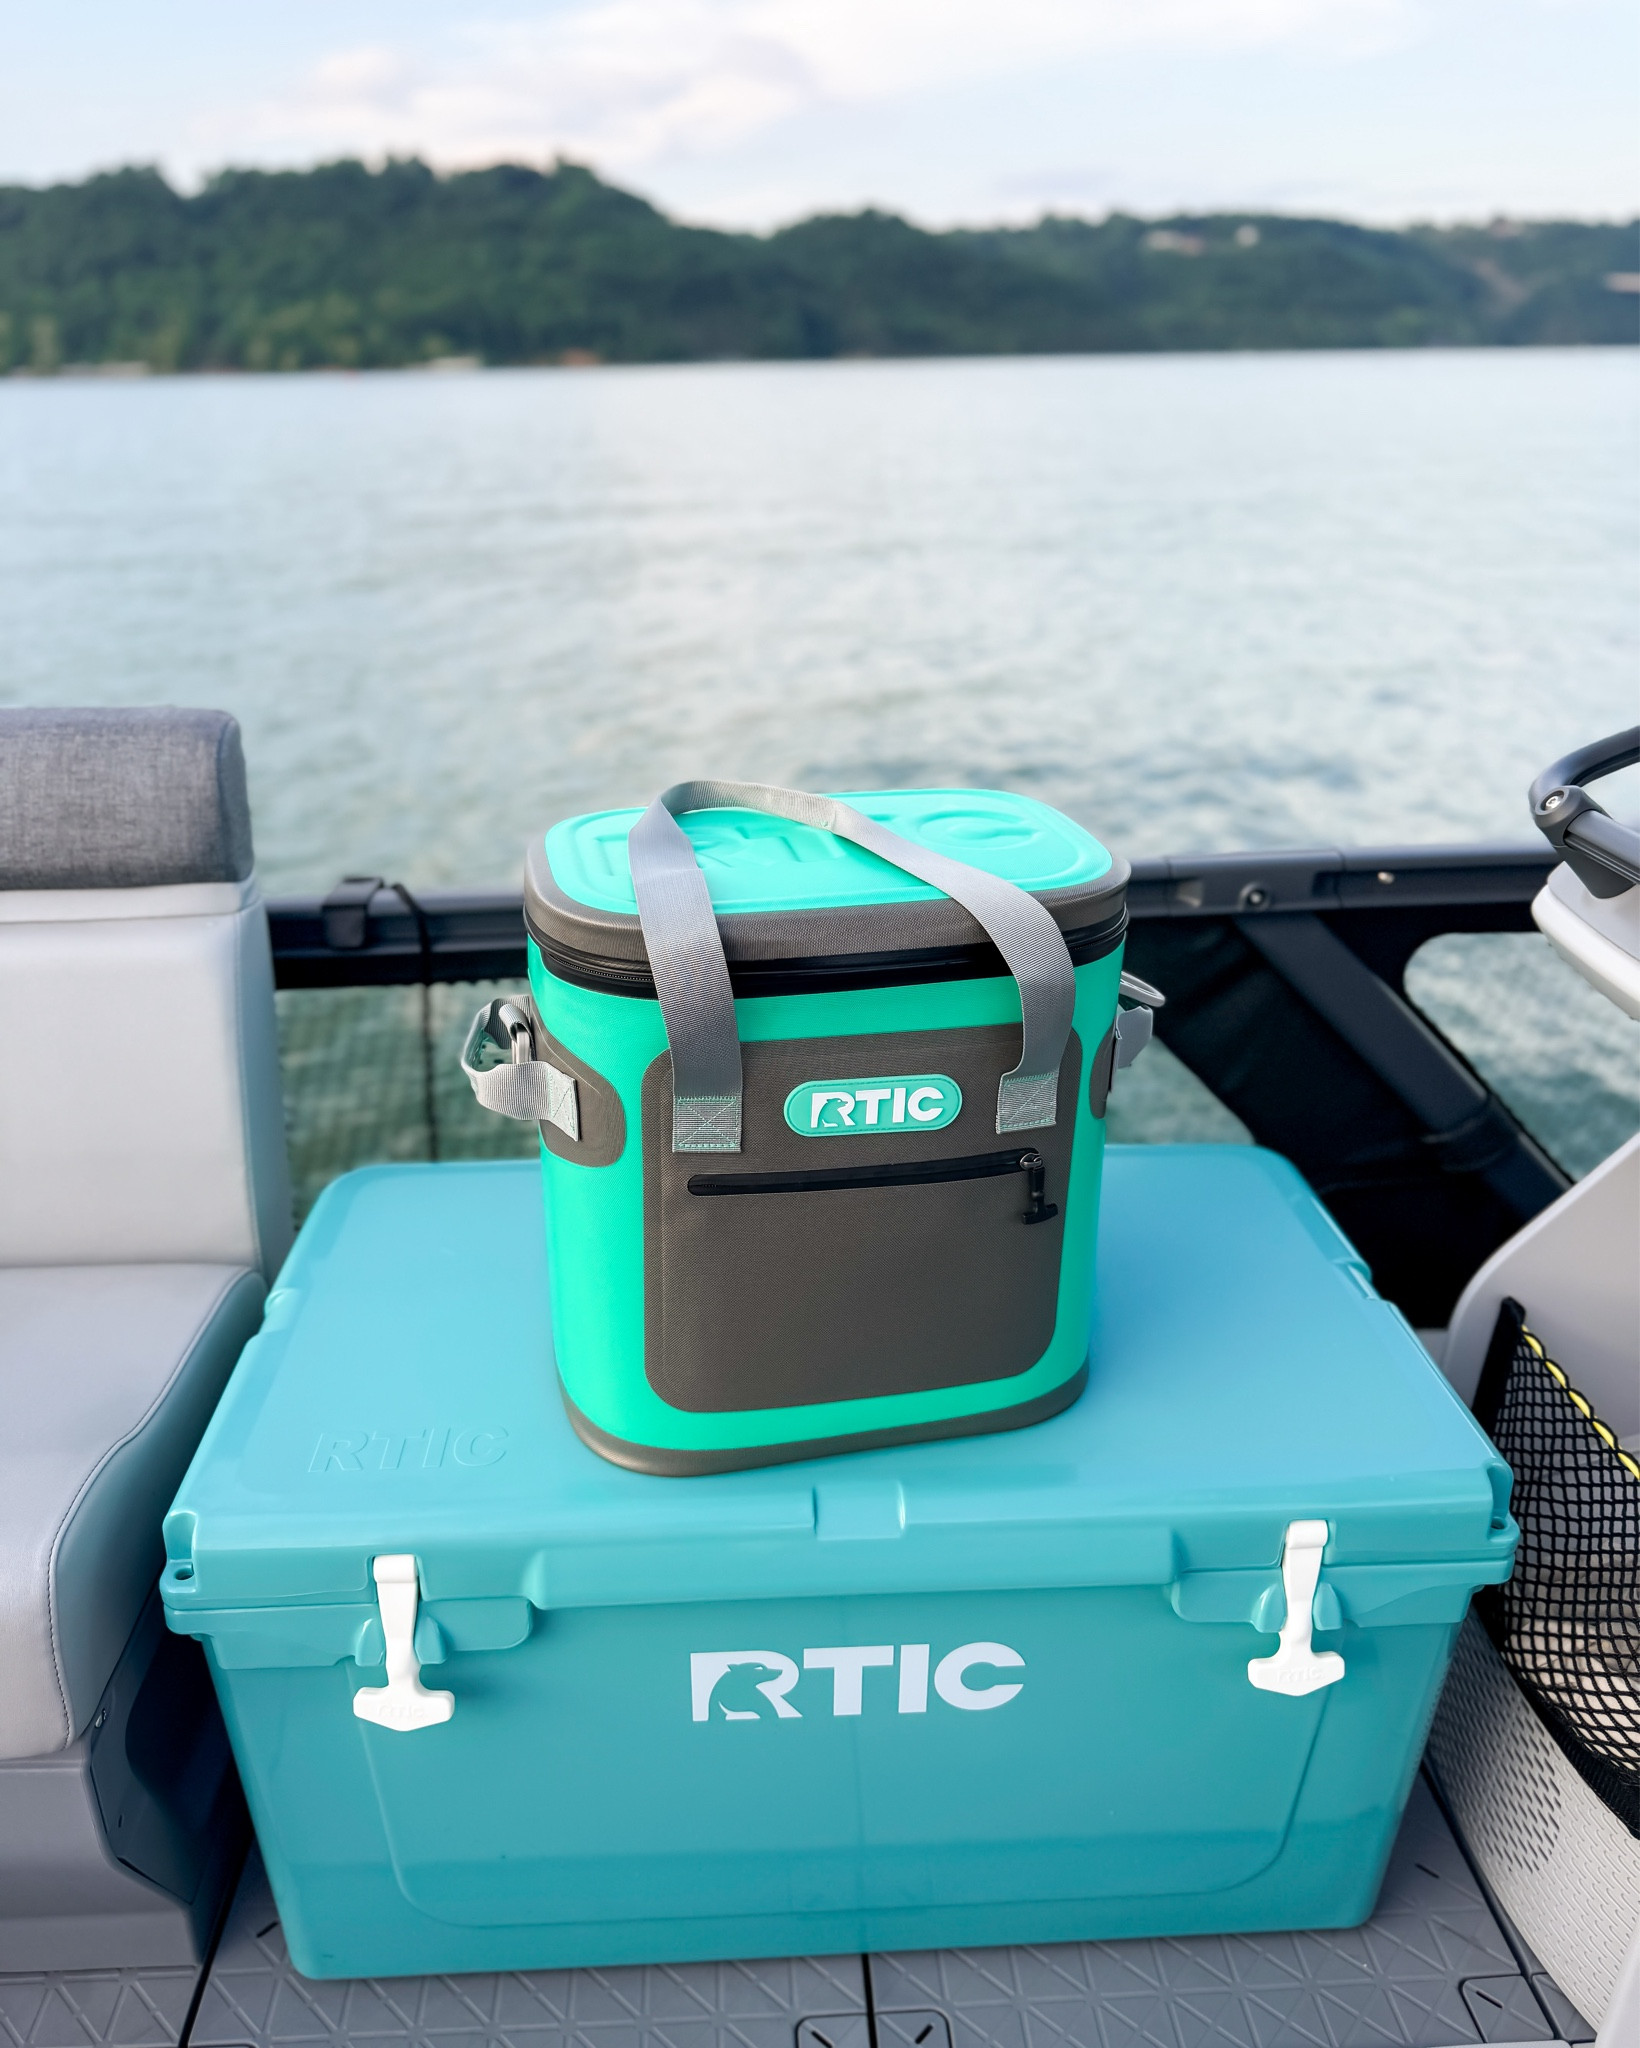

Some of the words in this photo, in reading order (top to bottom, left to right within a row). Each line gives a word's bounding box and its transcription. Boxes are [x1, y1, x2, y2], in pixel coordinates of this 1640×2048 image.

[811, 1087, 944, 1128] RTIC
[308, 1427, 509, 1472] RTIC
[690, 1642, 1026, 1722] RTIC
